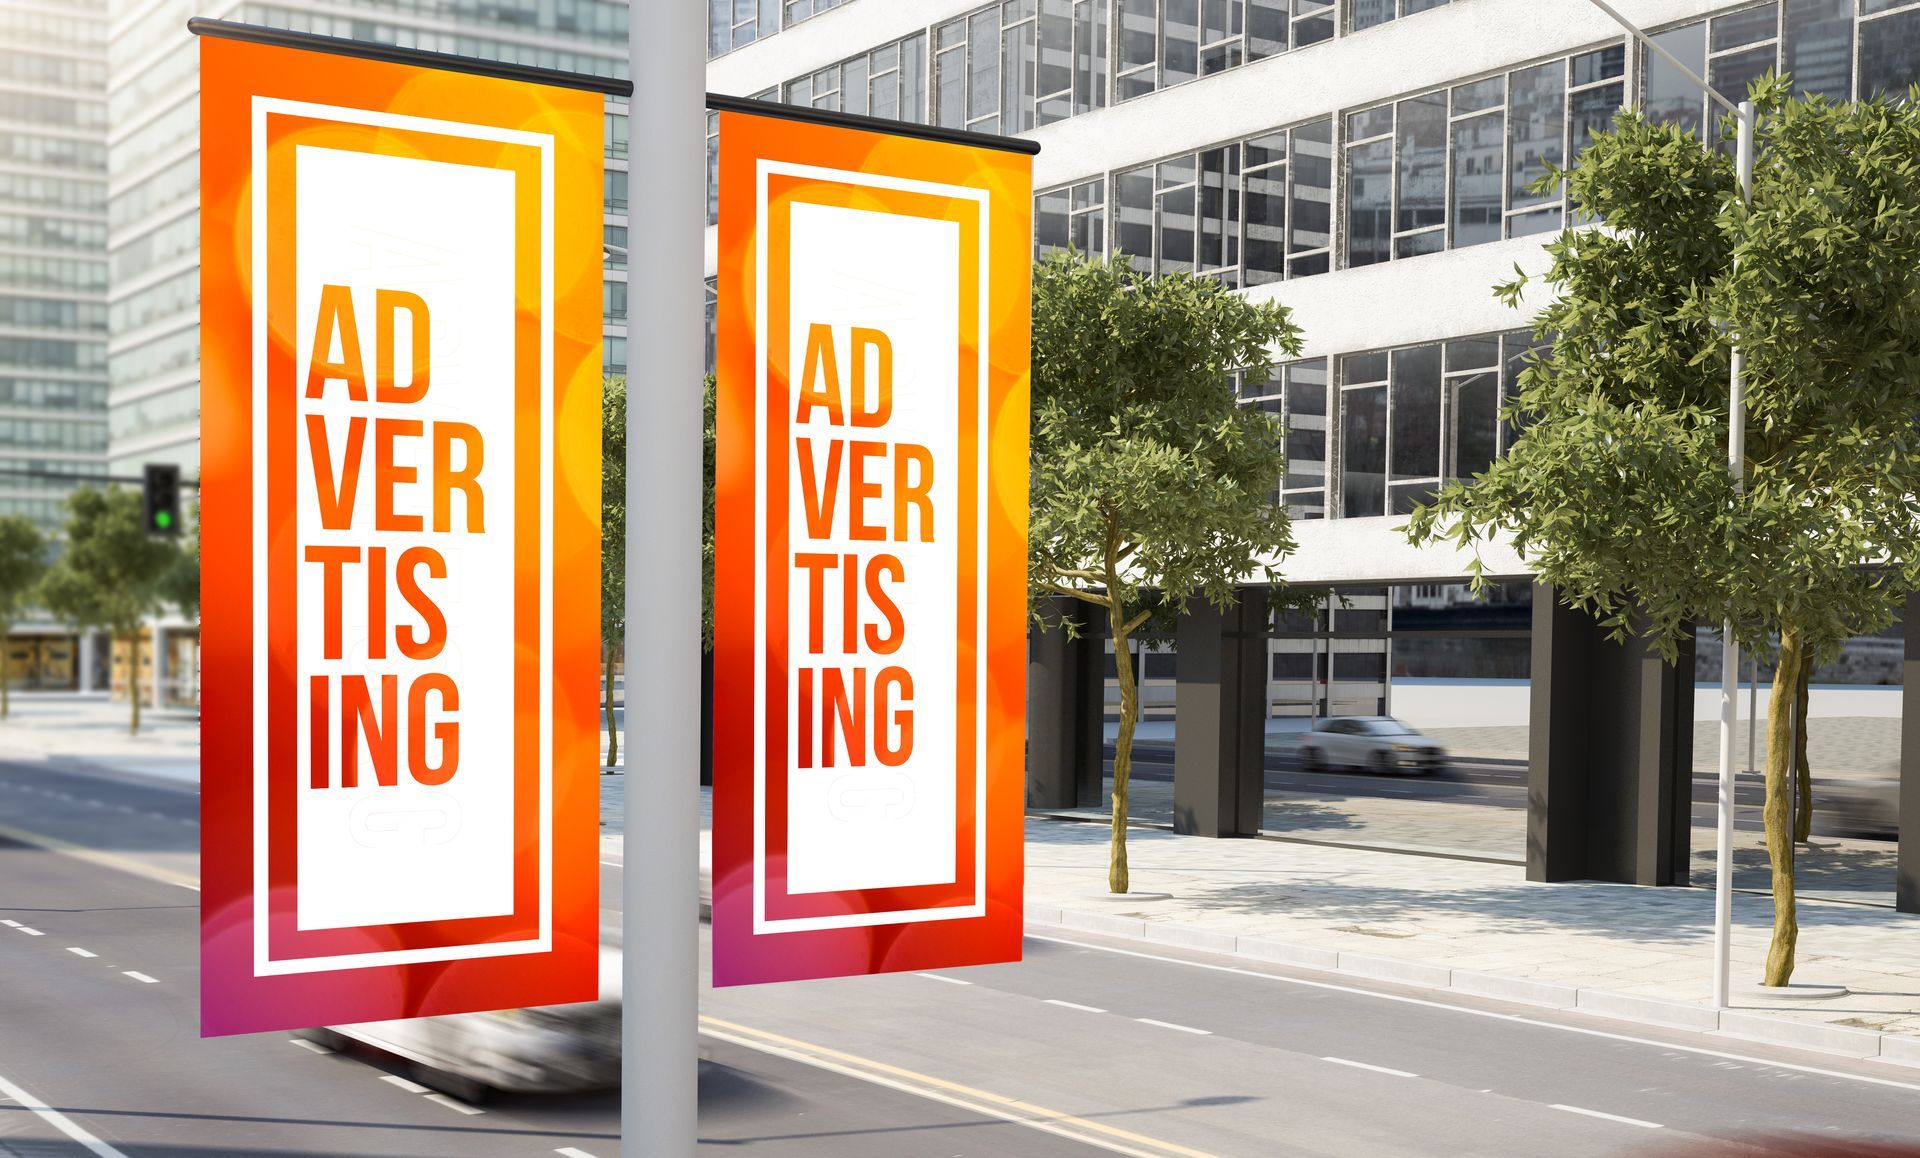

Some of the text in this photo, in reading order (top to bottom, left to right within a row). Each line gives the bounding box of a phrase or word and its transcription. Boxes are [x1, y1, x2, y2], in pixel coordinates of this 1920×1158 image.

[304, 283, 431, 405] AD
[795, 322, 893, 429] AD
[304, 413, 486, 535] VER
[795, 436, 935, 543] VER
[304, 544, 448, 661] TIS
[794, 552, 905, 656] TIS
[309, 672, 460, 790] ING
[797, 665, 914, 769] ING
